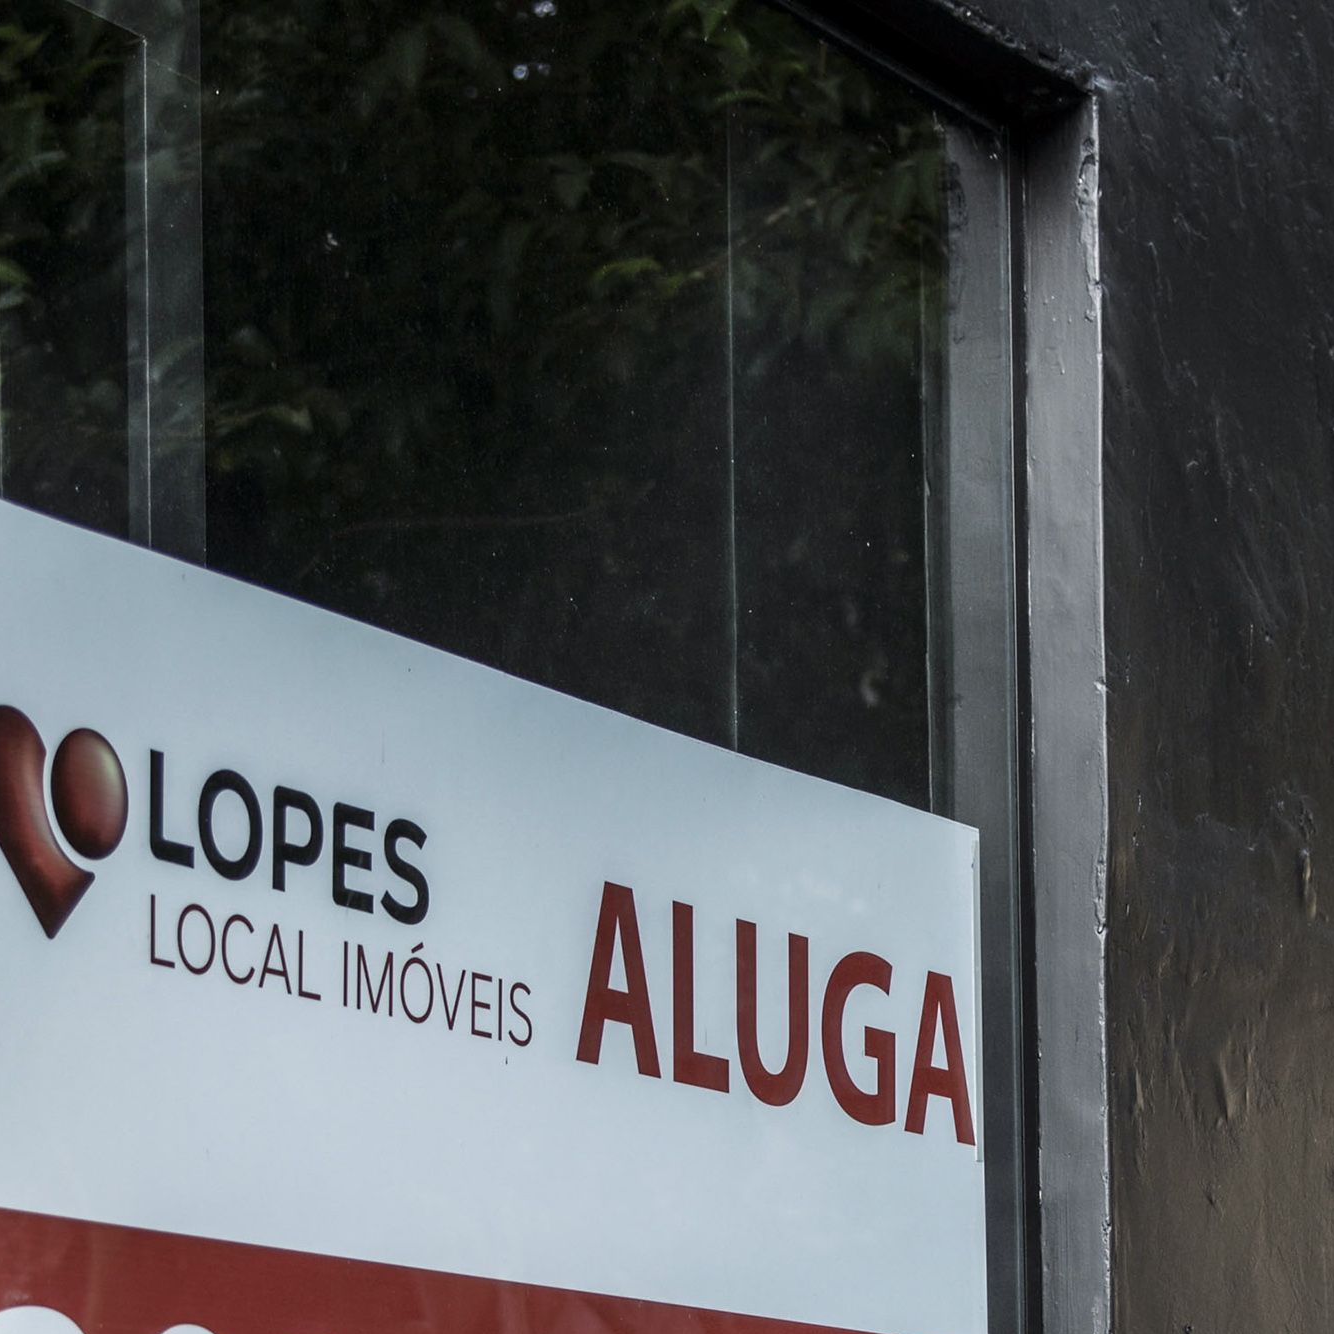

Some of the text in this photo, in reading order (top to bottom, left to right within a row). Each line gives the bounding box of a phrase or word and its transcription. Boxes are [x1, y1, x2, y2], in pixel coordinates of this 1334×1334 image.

[149, 748, 430, 926] LOPES
[150, 892, 534, 1047] LOCAL IMÓVEIS
[575, 880, 977, 1146] ALUGA
